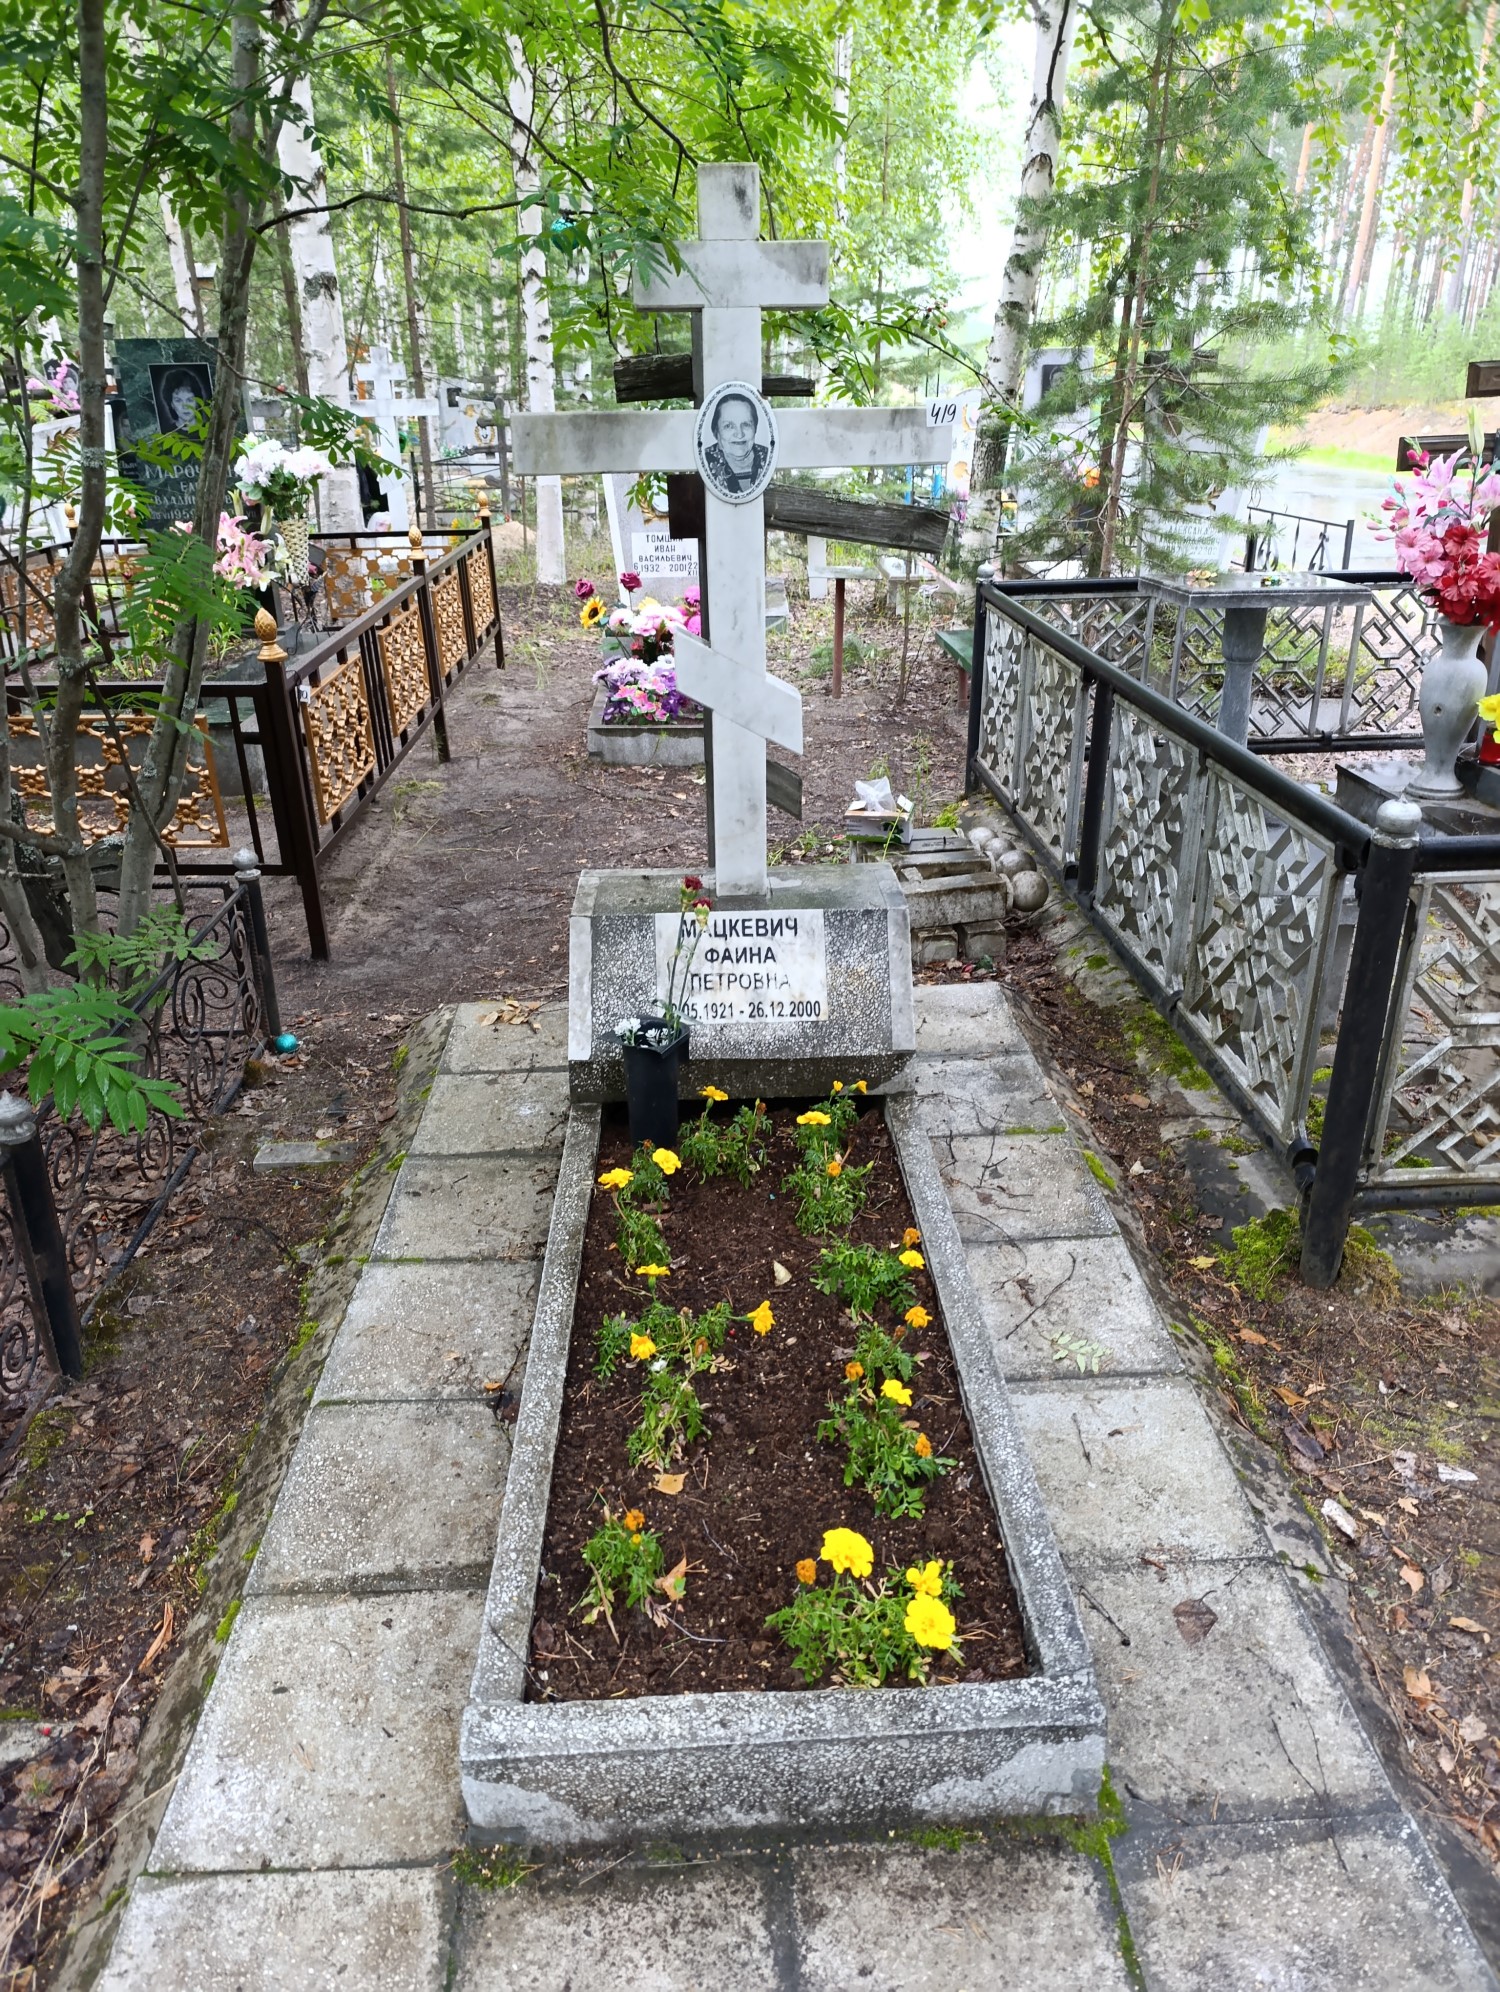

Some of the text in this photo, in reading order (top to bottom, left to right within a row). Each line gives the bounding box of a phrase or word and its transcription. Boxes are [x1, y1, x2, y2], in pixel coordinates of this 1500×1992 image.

[930, 402, 957, 425] 419
[646, 534, 683, 543] ТОМШ
[654, 544, 676, 553] ИВАН
[638, 554, 692, 562] ВАСИЛЬЕВИЧ
[641, 564, 660, 573] 1932
[669, 563, 687, 572] 2001
[687, 561, 698, 570] 22
[704, 946, 777, 964] ФАИНА
[690, 972, 791, 992] ПЕТРОВНА
[748, 1000, 821, 1018] 26.12.2000
